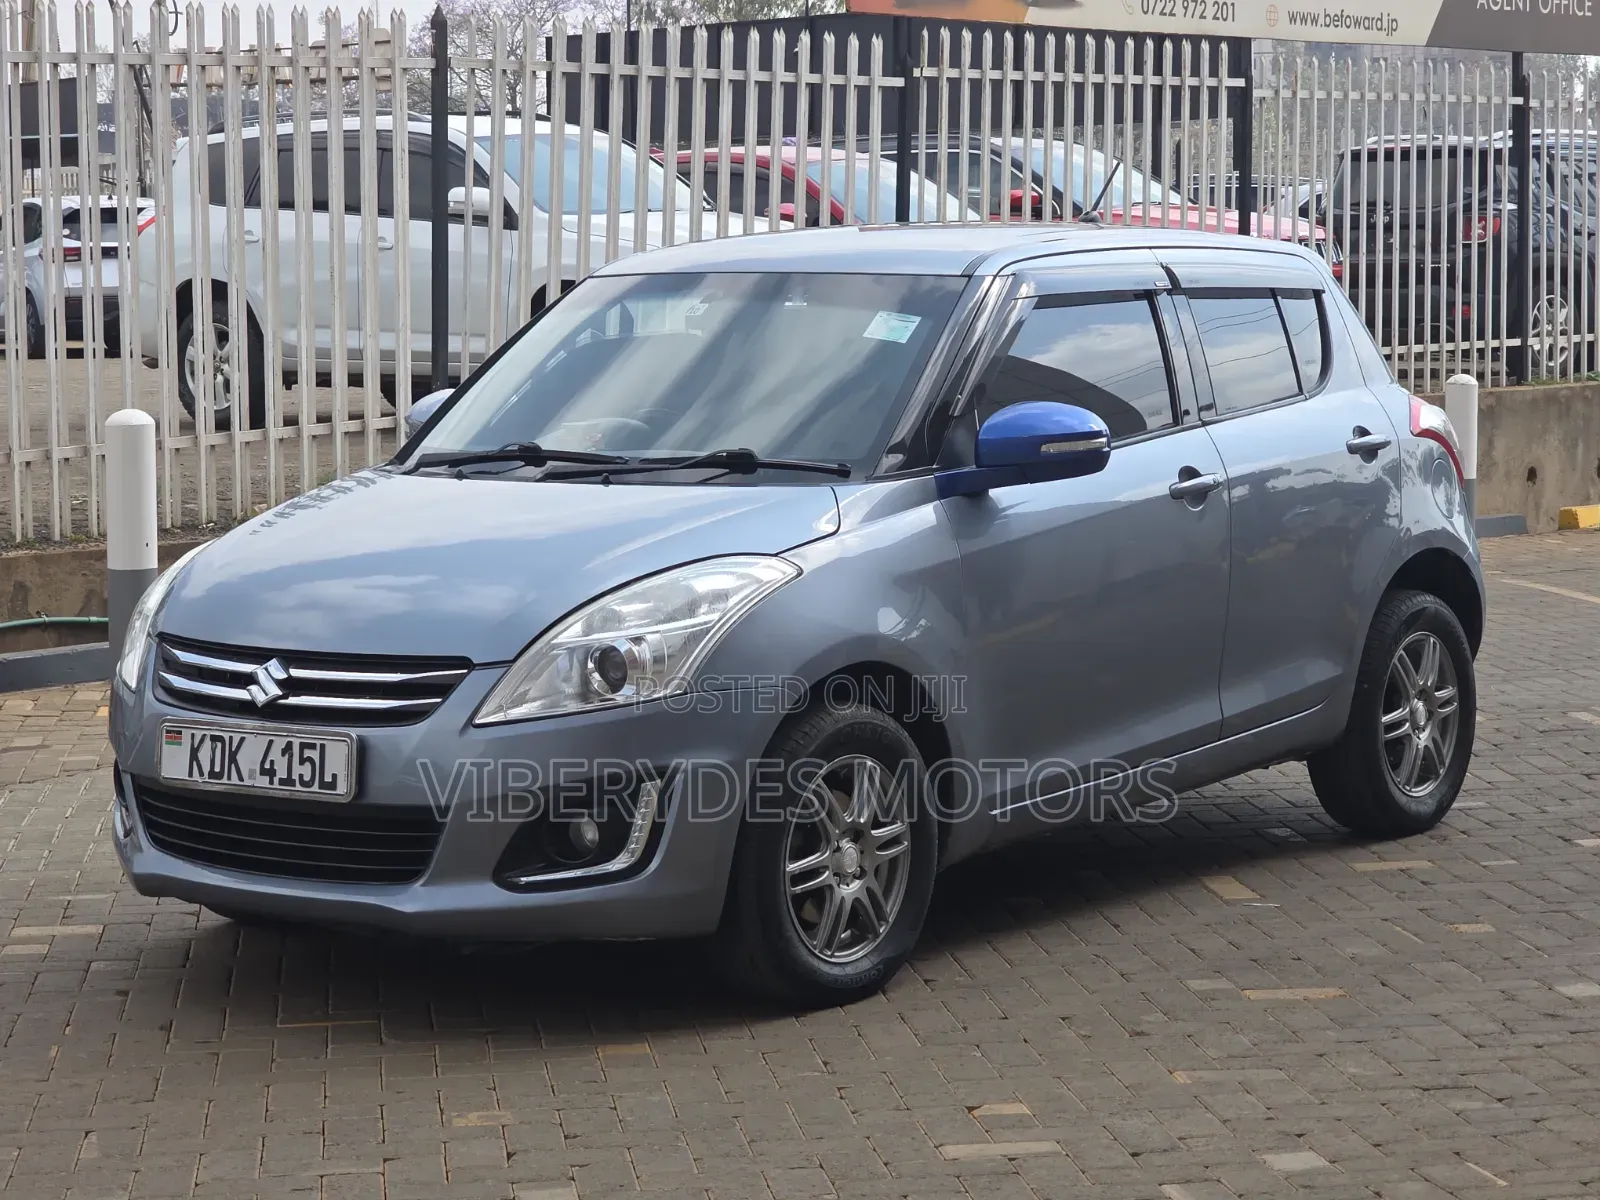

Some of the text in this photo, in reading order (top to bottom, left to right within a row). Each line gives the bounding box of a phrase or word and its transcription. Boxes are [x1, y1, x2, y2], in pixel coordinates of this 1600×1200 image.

[1141, 0, 1235, 22] 0722 972 201
[1539, 0, 1592, 16] OFFICE
[1288, 9, 1399, 36] www.befoward.jp
[187, 732, 246, 783] KDK
[259, 738, 338, 791] 415L
